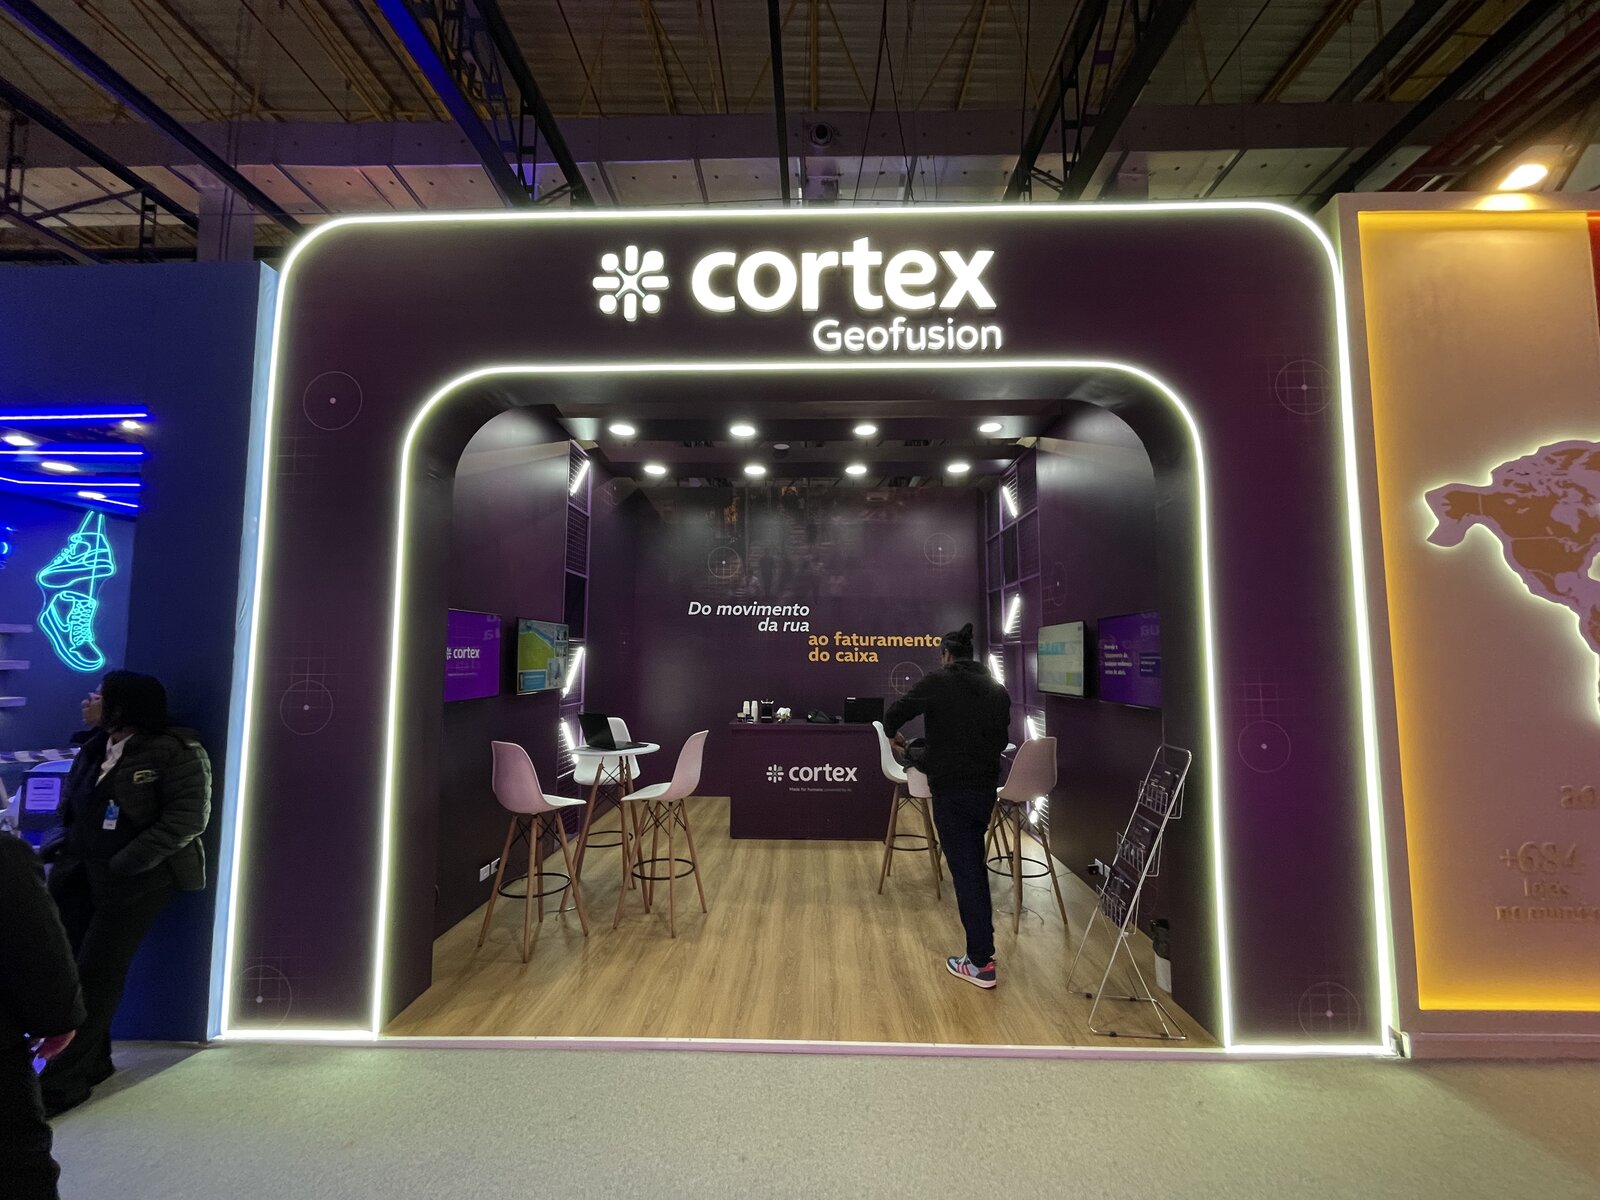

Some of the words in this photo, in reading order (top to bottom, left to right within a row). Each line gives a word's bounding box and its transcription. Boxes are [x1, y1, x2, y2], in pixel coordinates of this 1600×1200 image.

[691, 236, 998, 312] cortex
[812, 317, 1002, 352] Geofusion
[688, 601, 712, 616] Do
[716, 601, 810, 617] movimento
[758, 617, 778, 632] da
[783, 621, 810, 632] rua
[808, 634, 829, 647] ao
[833, 631, 942, 647] faturamento
[453, 646, 481, 659] cortex
[808, 648, 830, 662] do
[835, 647, 879, 663] caixa
[788, 763, 858, 782] cortex
